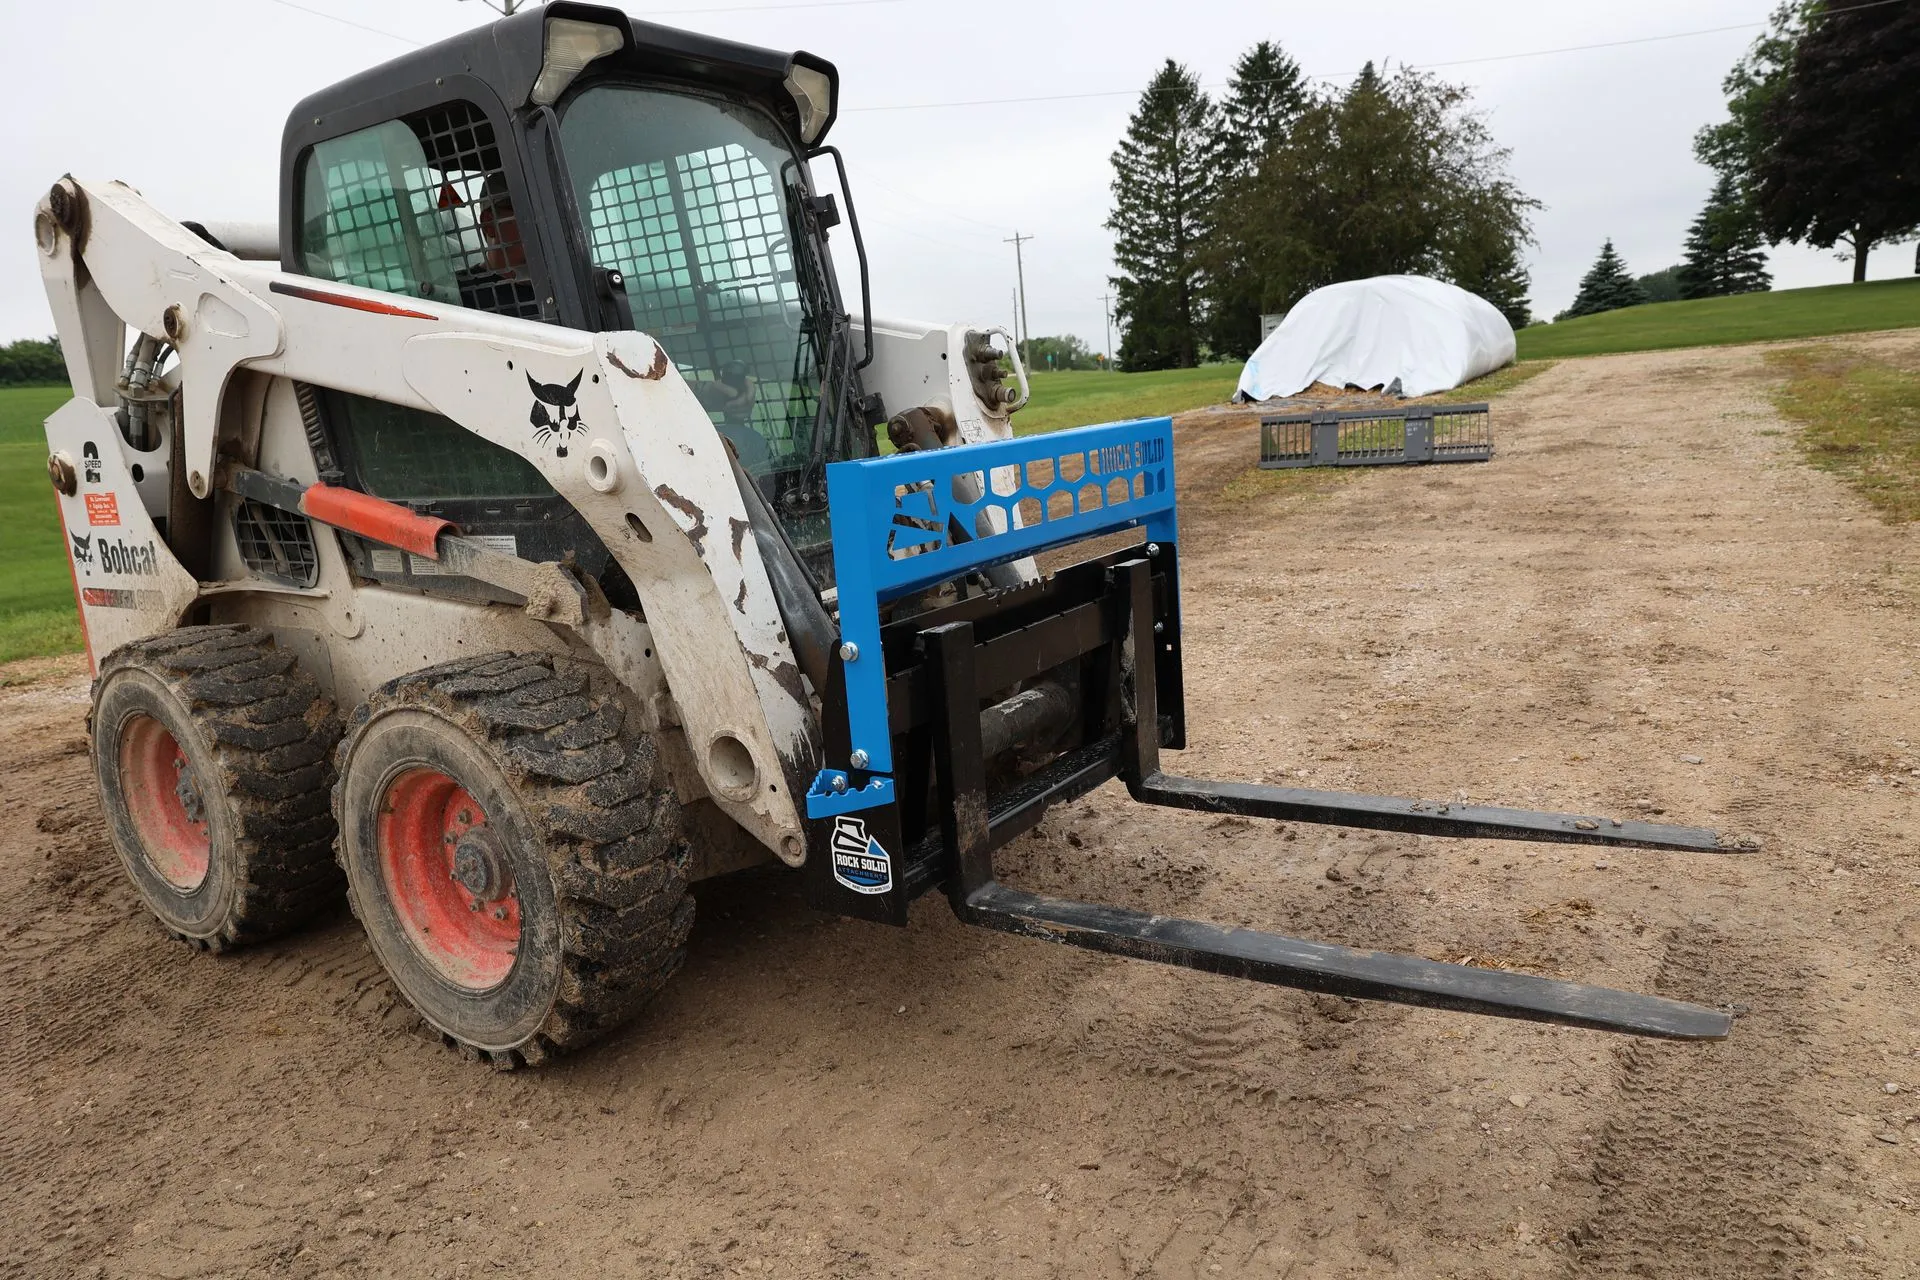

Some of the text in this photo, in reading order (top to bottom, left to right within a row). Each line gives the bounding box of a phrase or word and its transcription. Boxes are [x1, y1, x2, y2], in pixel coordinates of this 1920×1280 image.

[85, 460, 101, 468] SPEED
[98, 538, 160, 577] Bobcat
[836, 854, 887, 873] ROCK SOLID
[838, 867, 888, 880] ATTACHMENTS
